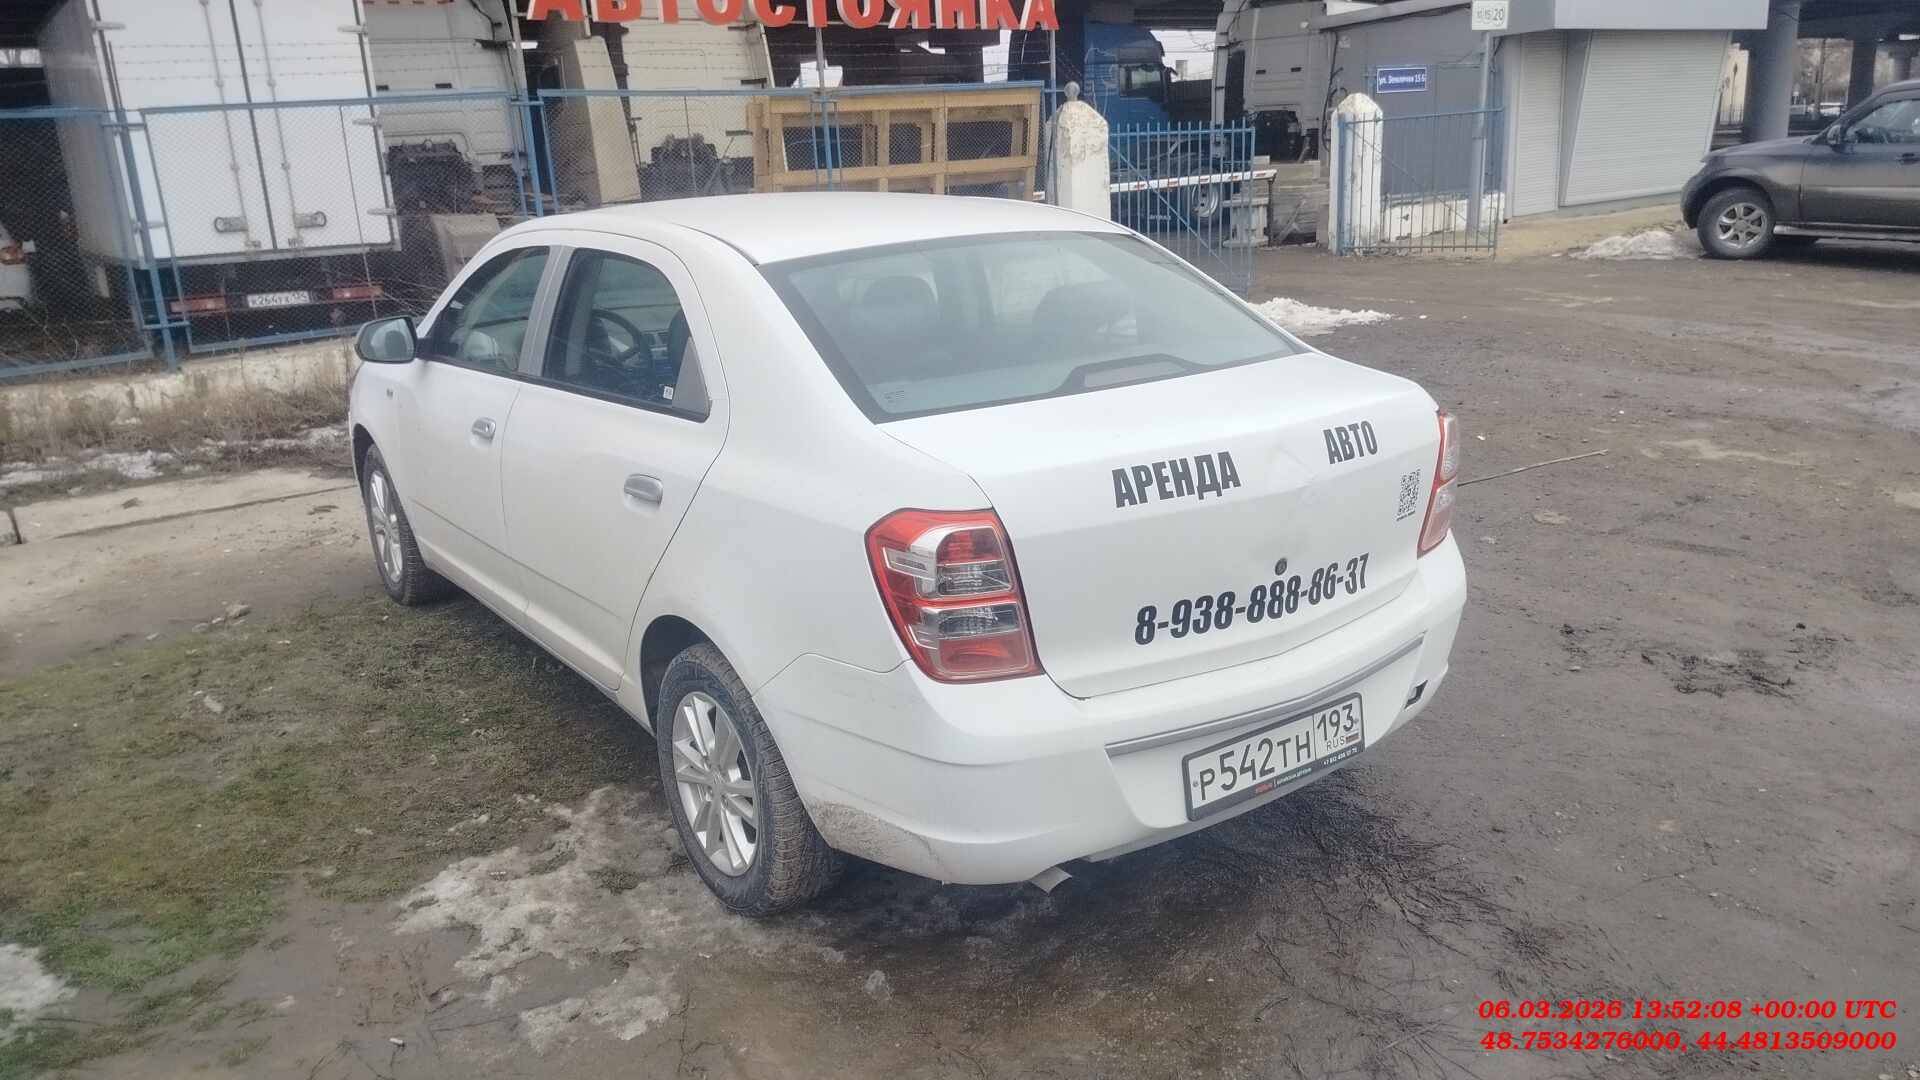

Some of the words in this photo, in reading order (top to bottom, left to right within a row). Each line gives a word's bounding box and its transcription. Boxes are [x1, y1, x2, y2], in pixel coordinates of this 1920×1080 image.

[527, 0, 1059, 31] АВТОСТОЯНКА
[1323, 421, 1378, 465] АВТО
[1112, 451, 1242, 508] АРЕНДА
[1134, 553, 1370, 646] 8-938-888-86-37
[1199, 730, 1311, 801] Р542ТН
[1316, 703, 1354, 741] 193
[1326, 735, 1346, 752] RUS
